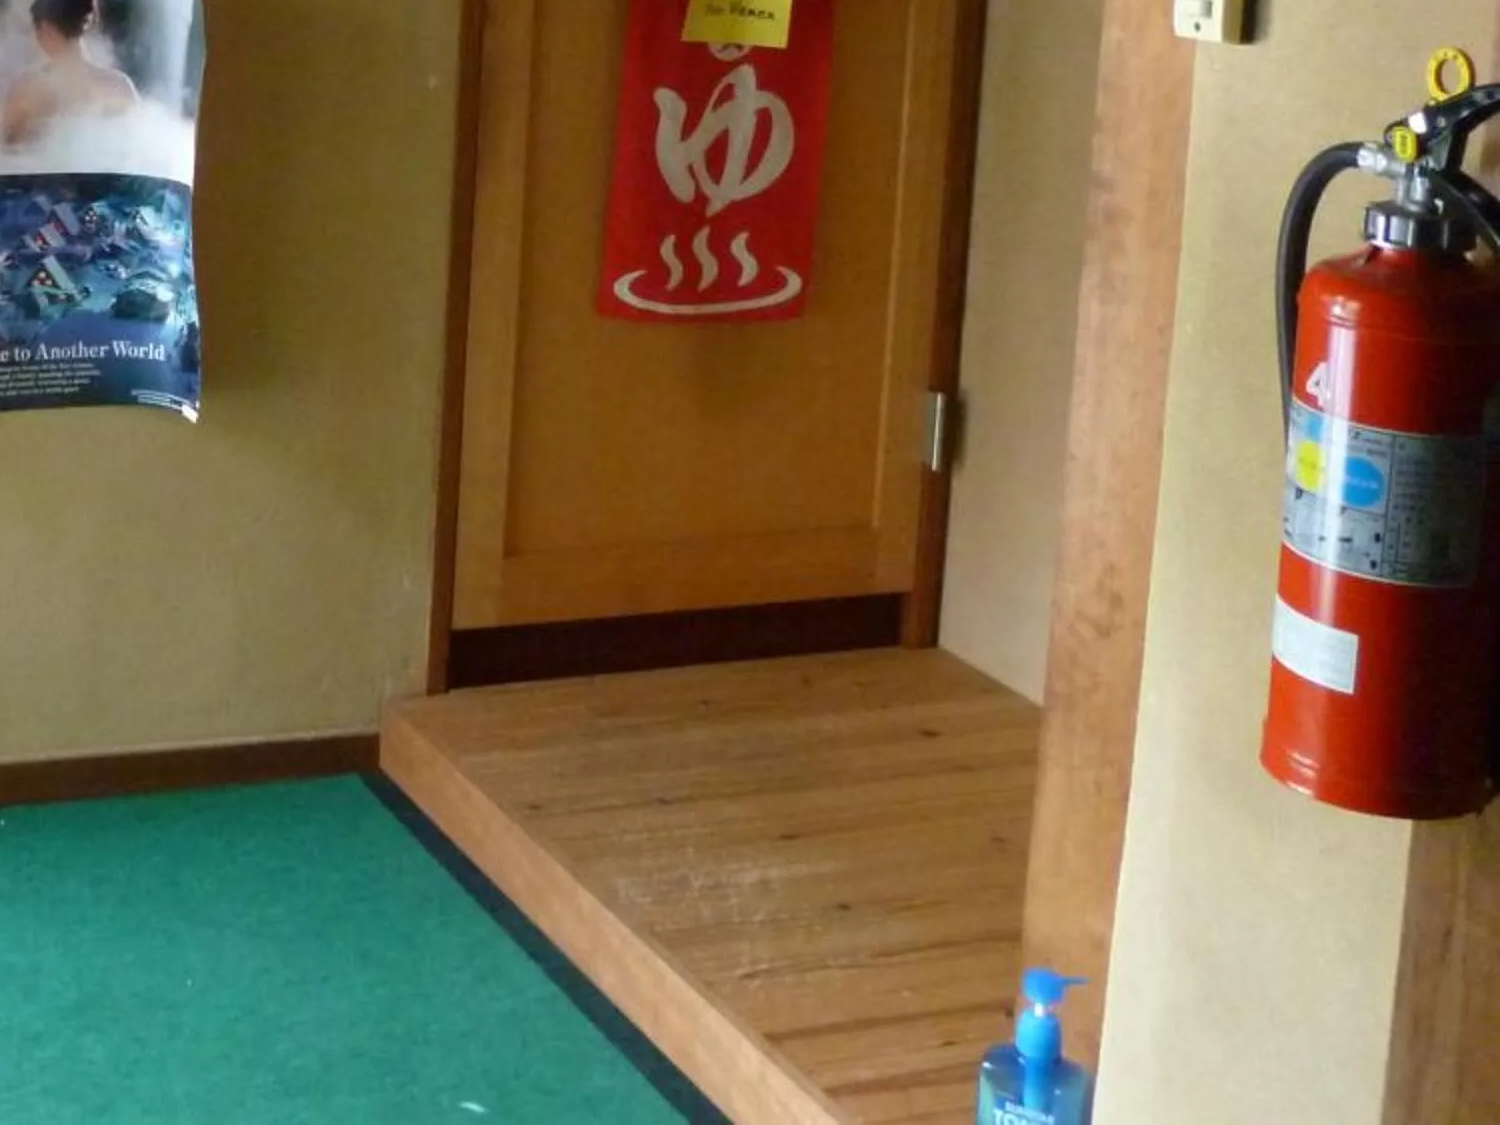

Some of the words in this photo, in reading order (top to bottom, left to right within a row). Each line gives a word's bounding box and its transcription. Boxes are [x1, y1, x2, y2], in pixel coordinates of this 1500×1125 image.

[653, 63, 795, 217] ゆ
[14, 345, 31, 362] to
[35, 338, 109, 361] Another
[112, 339, 166, 362] World
